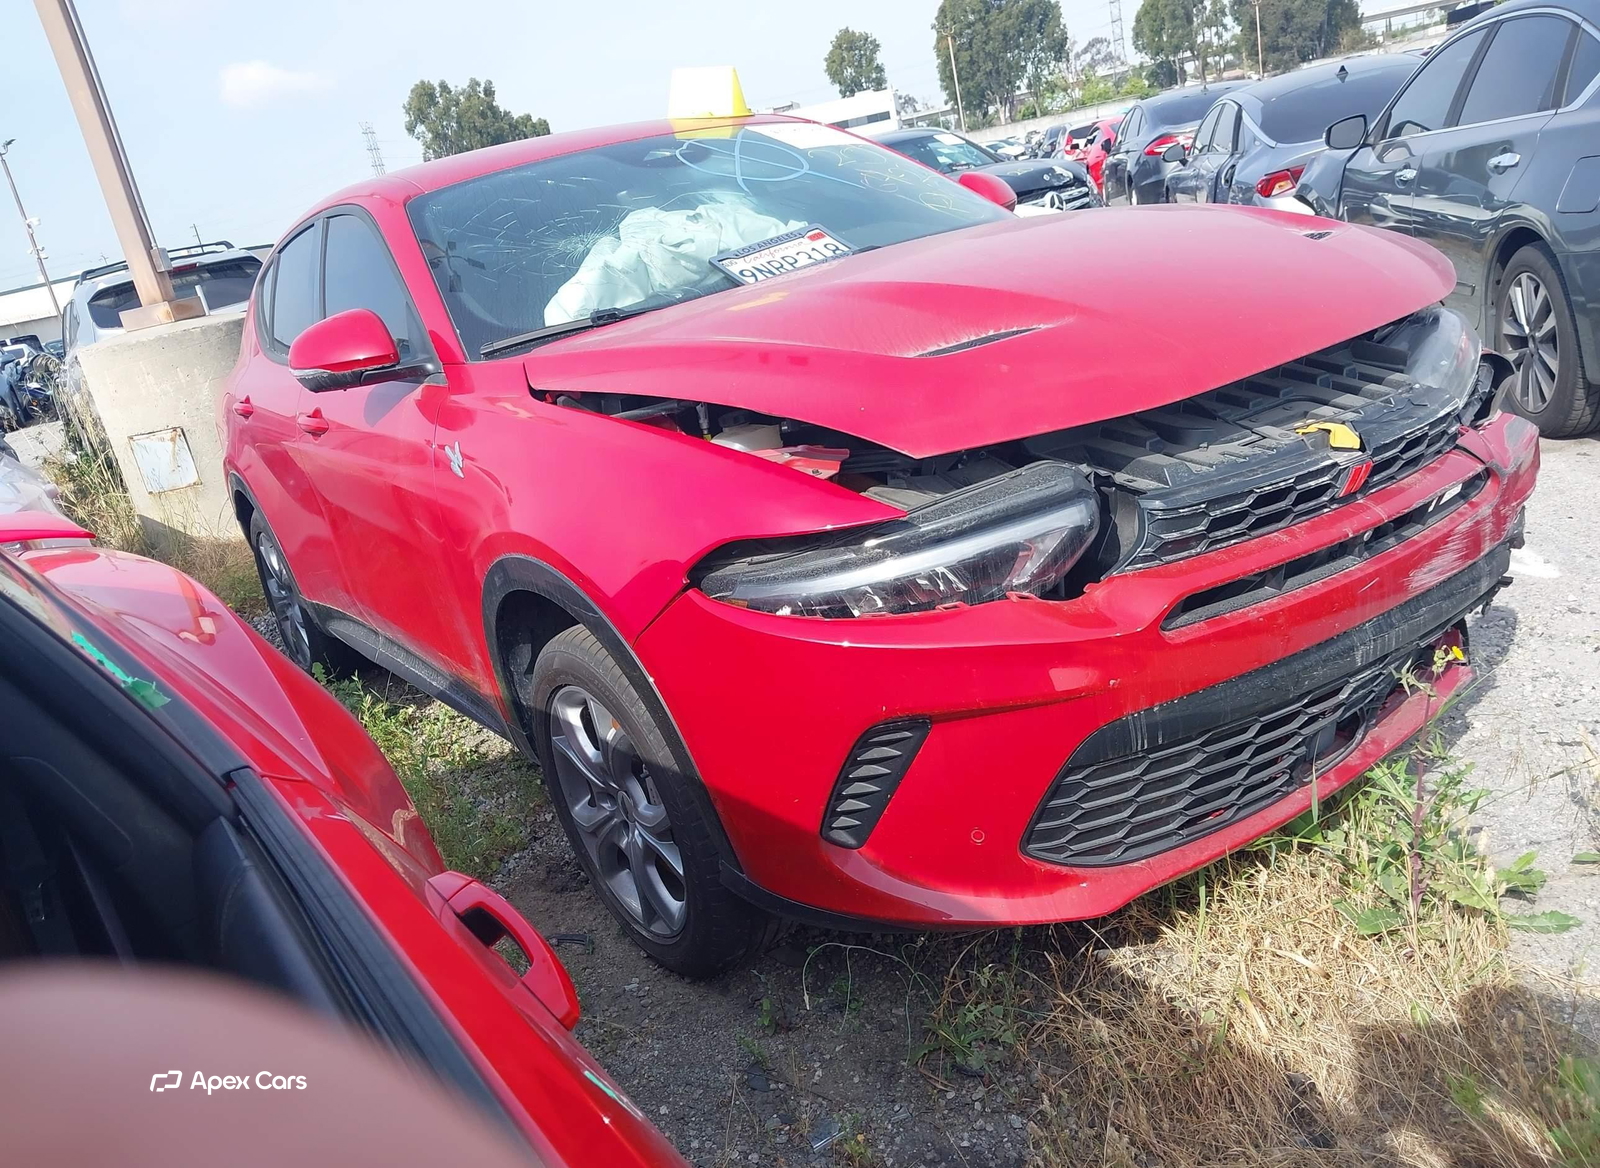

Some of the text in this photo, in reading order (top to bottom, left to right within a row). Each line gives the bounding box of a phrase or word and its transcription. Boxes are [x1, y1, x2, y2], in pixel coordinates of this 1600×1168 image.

[738, 245, 757, 256] LOS
[757, 233, 798, 249] ANGELES
[742, 241, 805, 265] California
[738, 243, 846, 282] 9NRP318
